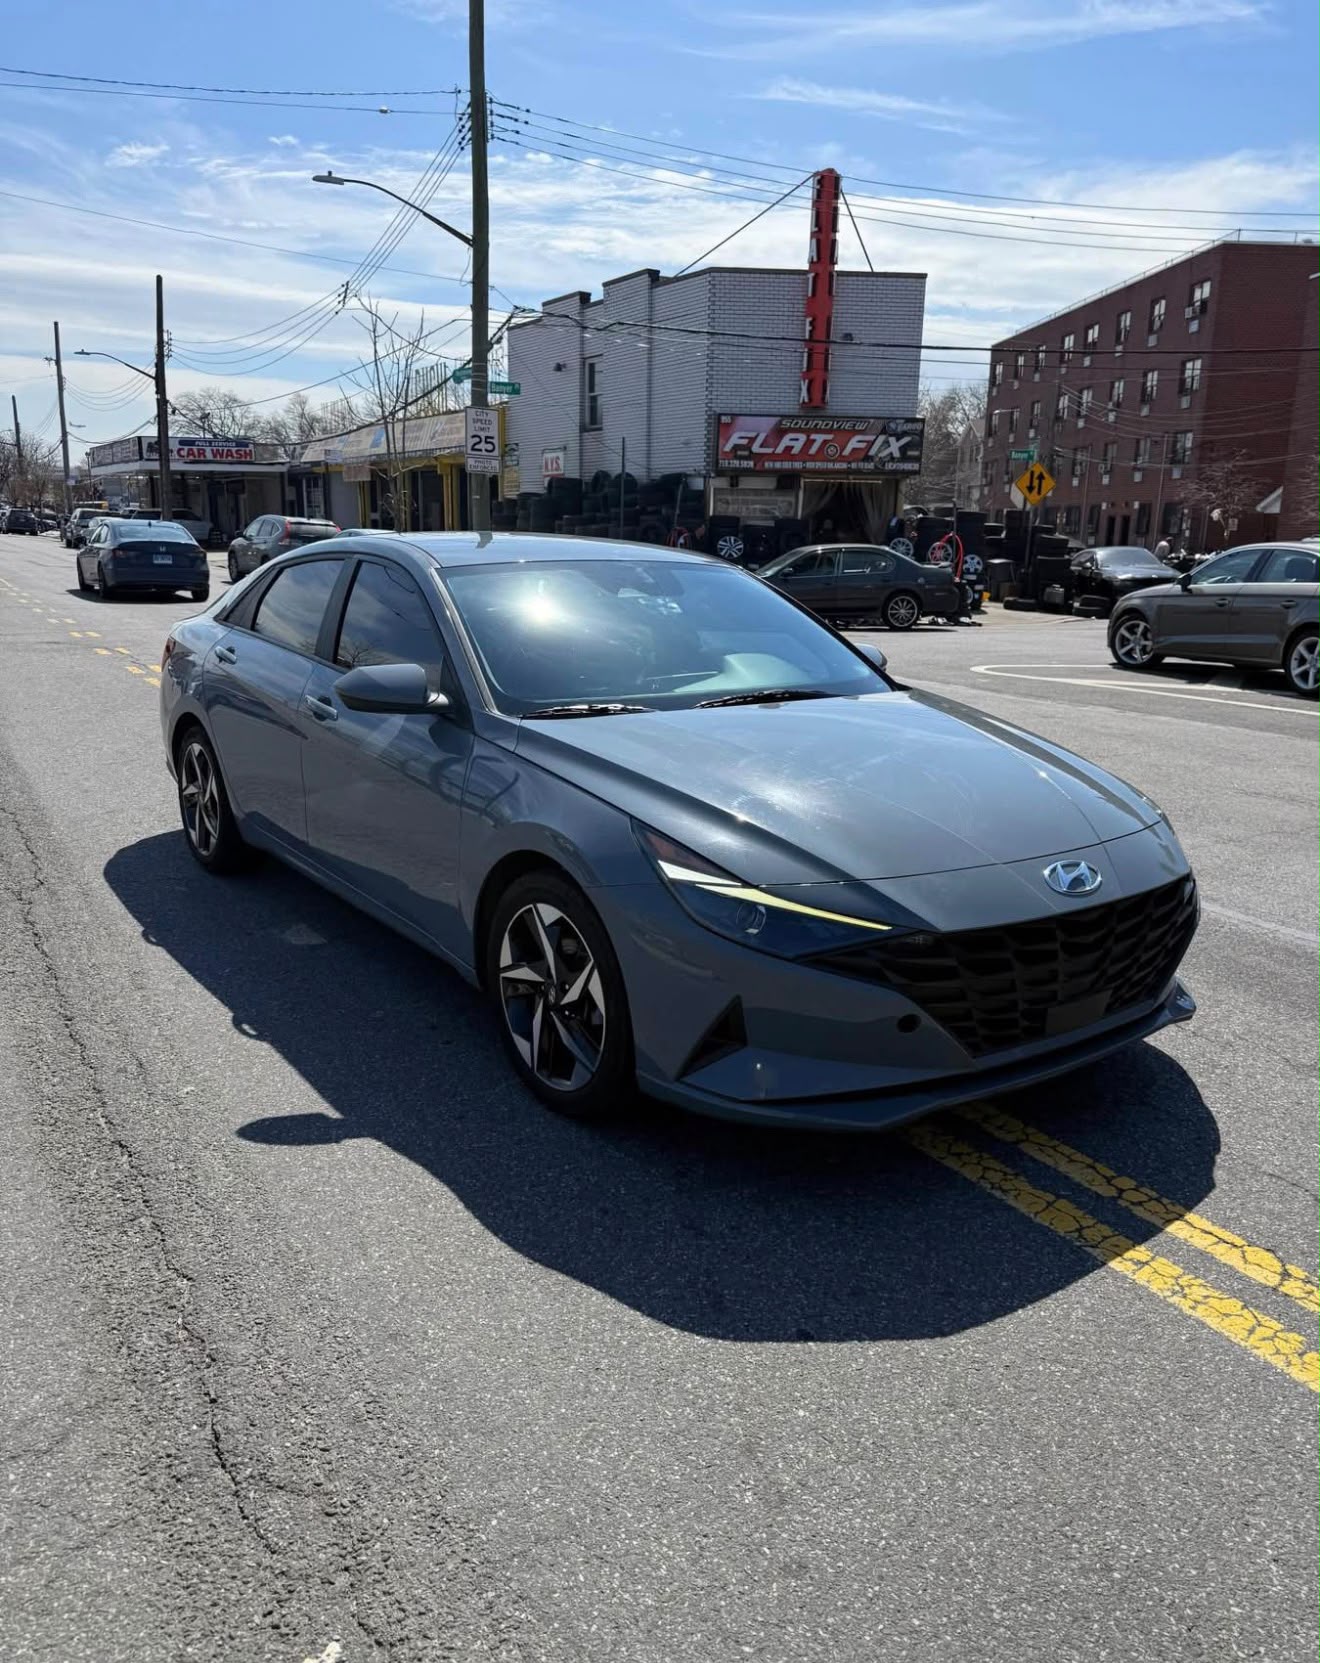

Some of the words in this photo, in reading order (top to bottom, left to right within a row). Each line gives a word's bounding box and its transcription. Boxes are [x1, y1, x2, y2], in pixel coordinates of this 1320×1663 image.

[472, 418, 492, 426] SPEED
[780, 418, 869, 431] SOUNDVIEW
[470, 435, 496, 453] 25
[723, 431, 834, 456] FLAT
[842, 434, 912, 458] FIX
[176, 447, 206, 459] CAR
[211, 448, 253, 460] WASH
